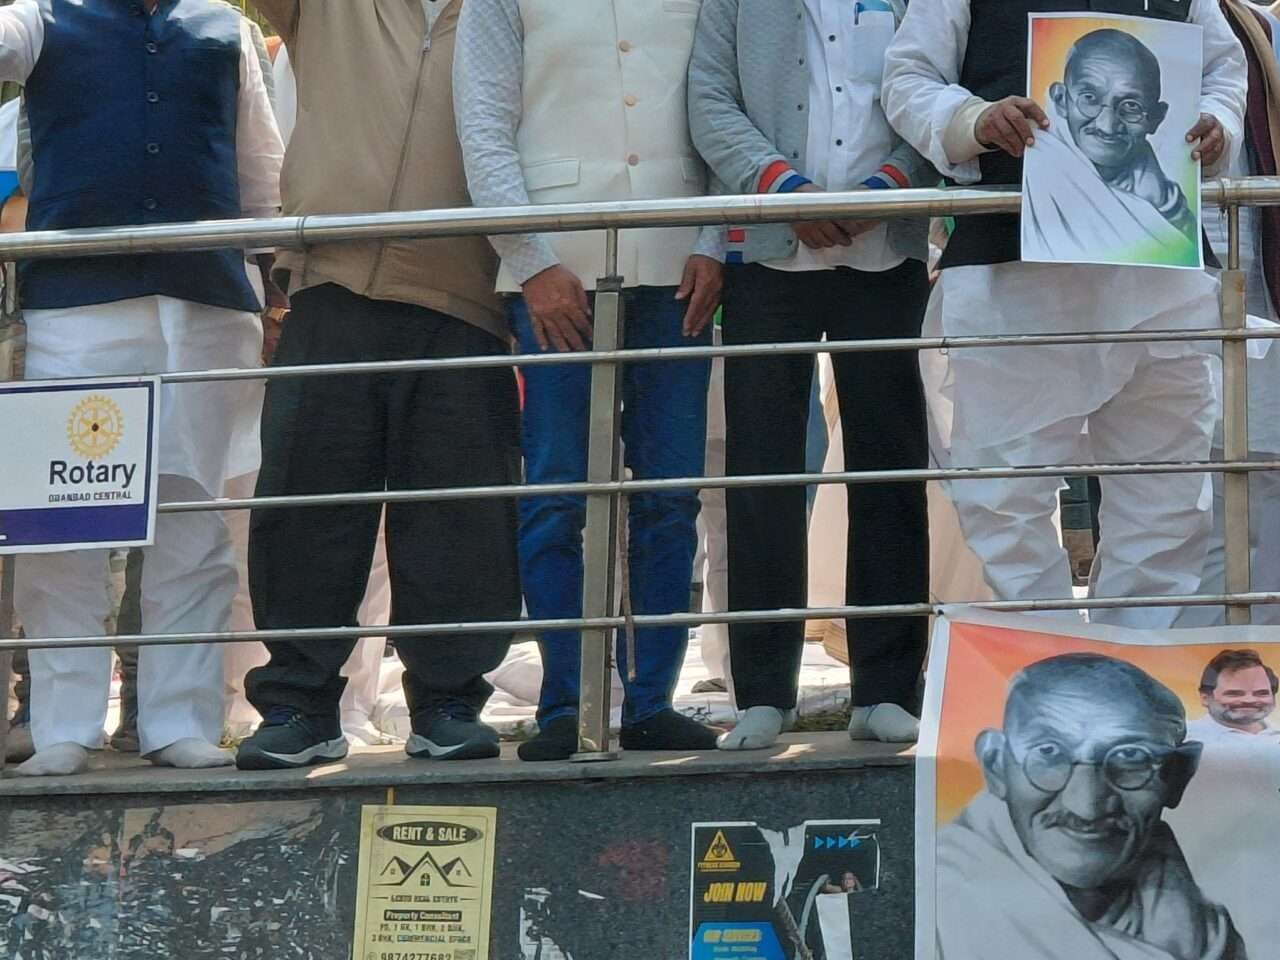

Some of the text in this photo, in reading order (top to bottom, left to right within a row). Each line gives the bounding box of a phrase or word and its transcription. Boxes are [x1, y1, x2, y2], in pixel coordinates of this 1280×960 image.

[49, 460, 137, 488] Rotary
[93, 490, 132, 501] CENTRAL
[392, 826, 467, 841] RENT & SALE
[703, 882, 767, 902] JOIN NOW
